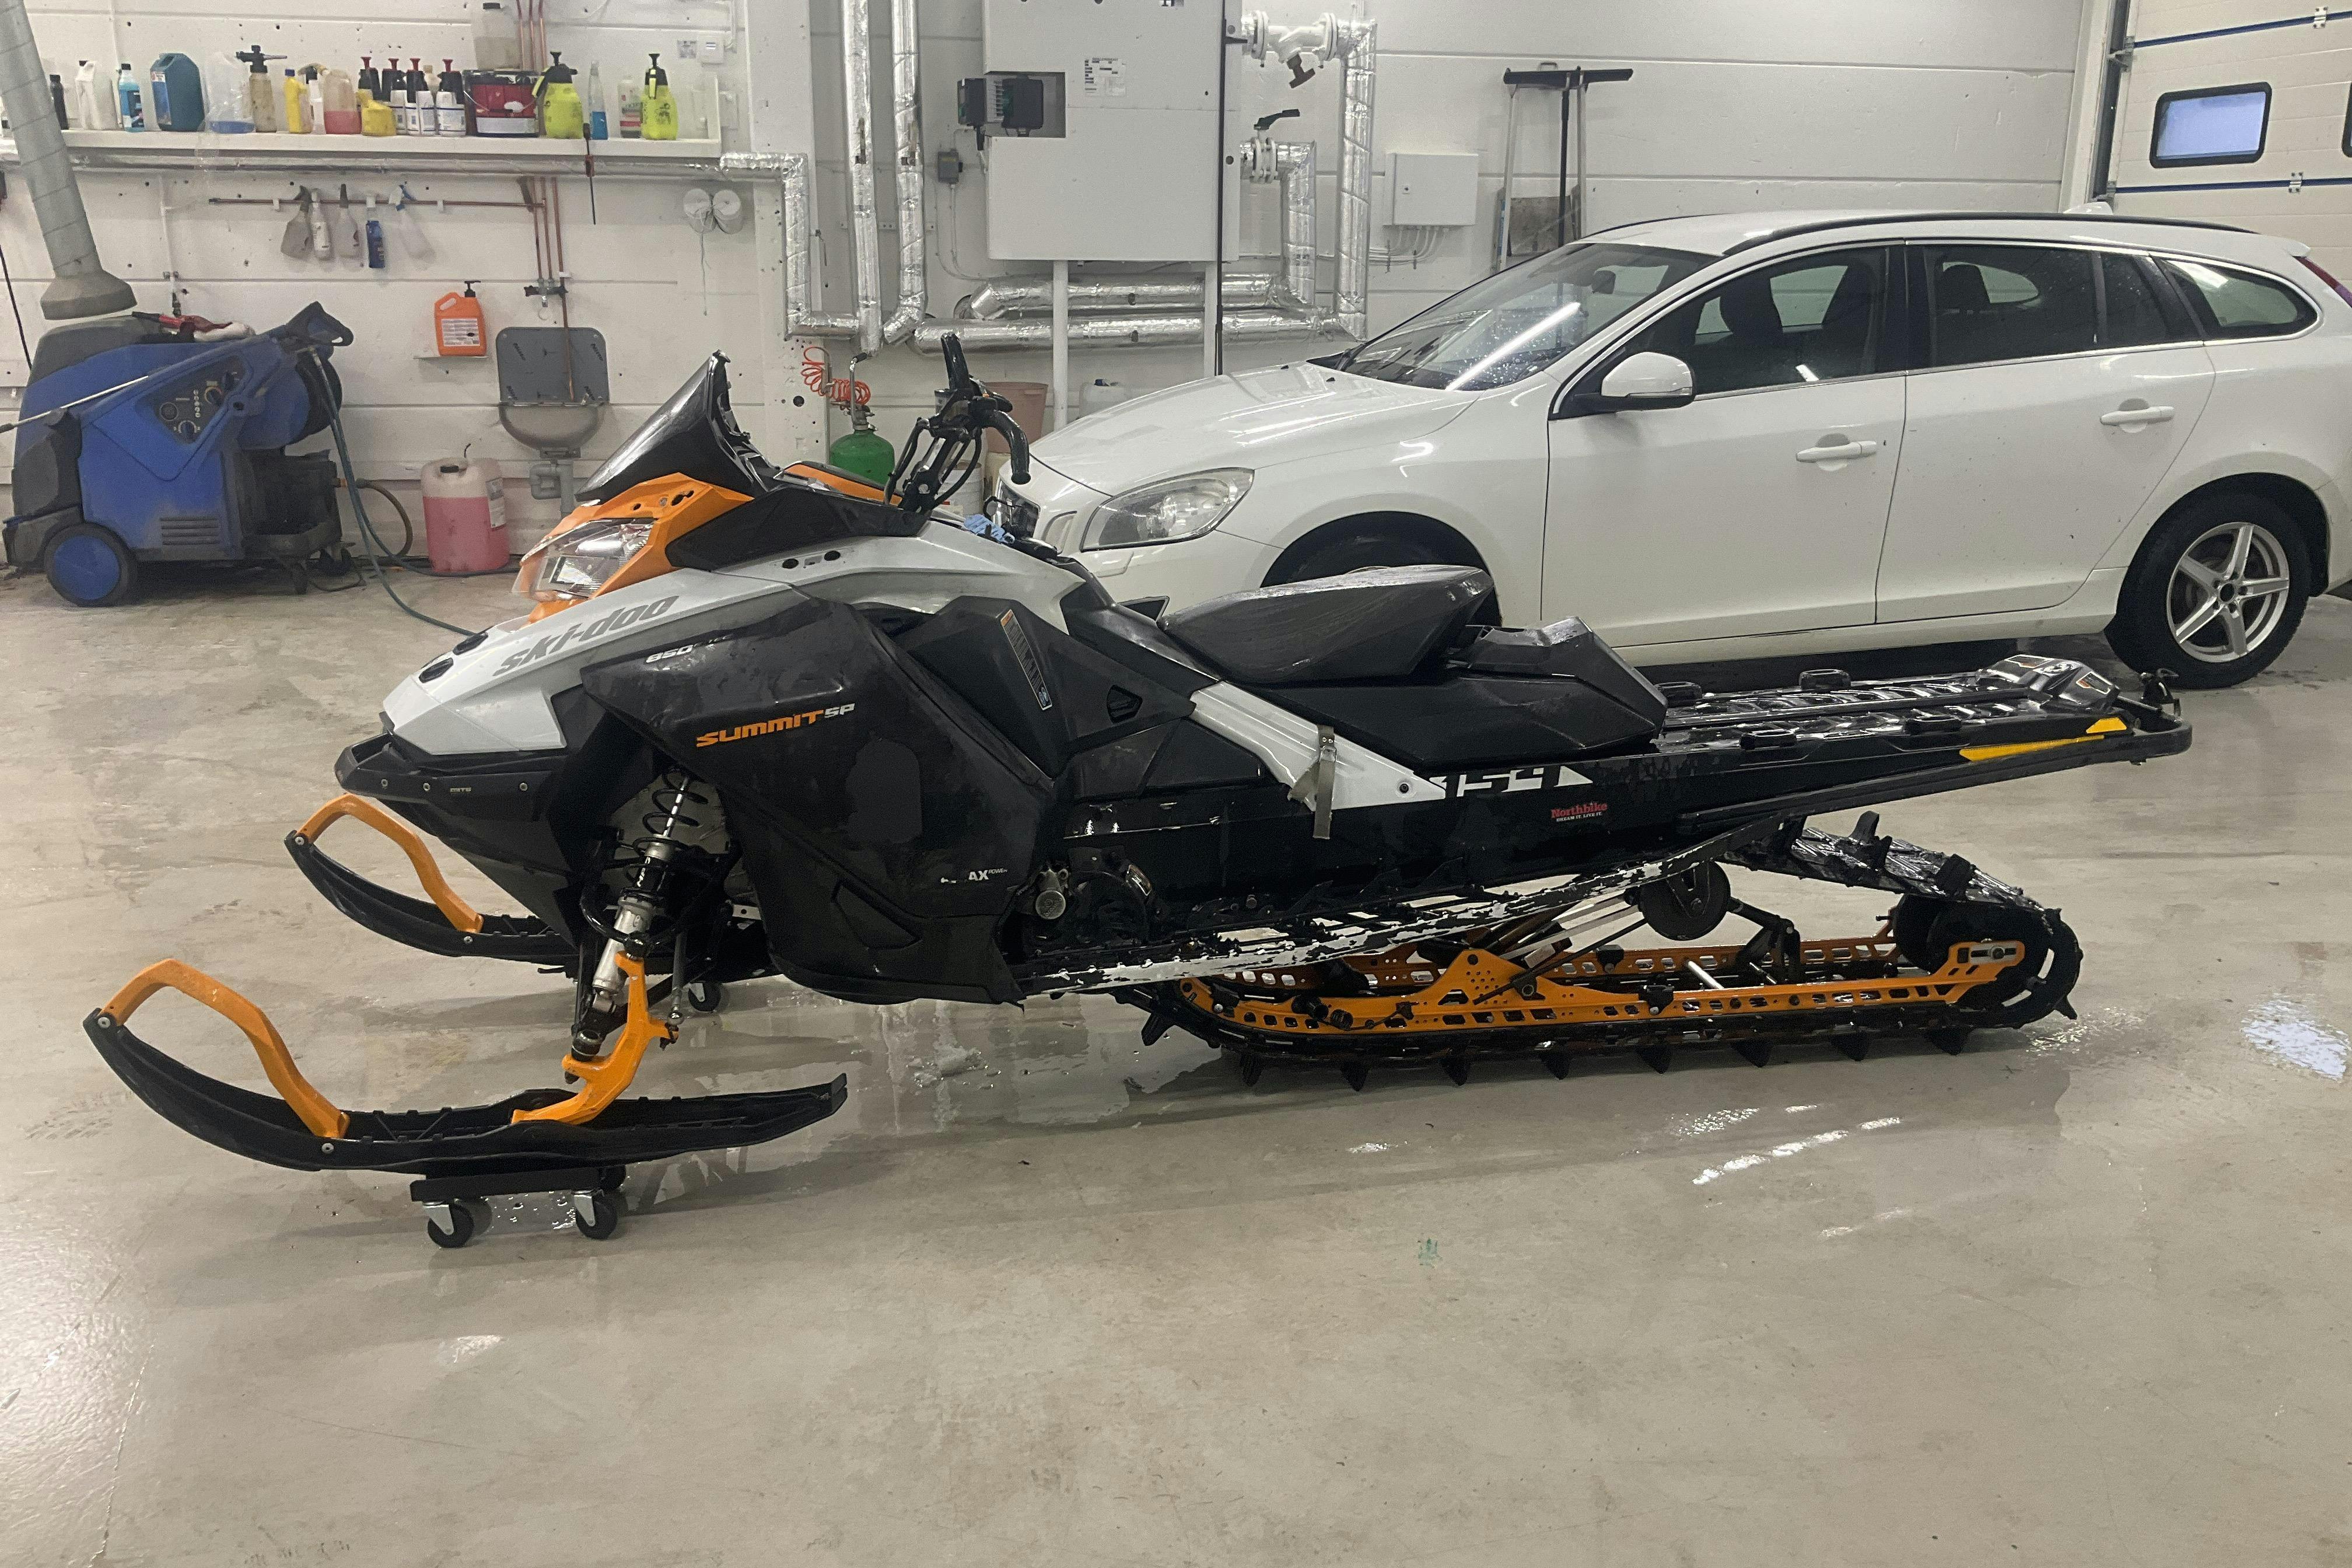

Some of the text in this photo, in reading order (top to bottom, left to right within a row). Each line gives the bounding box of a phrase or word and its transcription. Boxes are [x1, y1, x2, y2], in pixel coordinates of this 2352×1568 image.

[646, 644, 694, 664] 850
[696, 703, 856, 747] SUMMIT SP
[1551, 802, 1608, 818] Northbike
